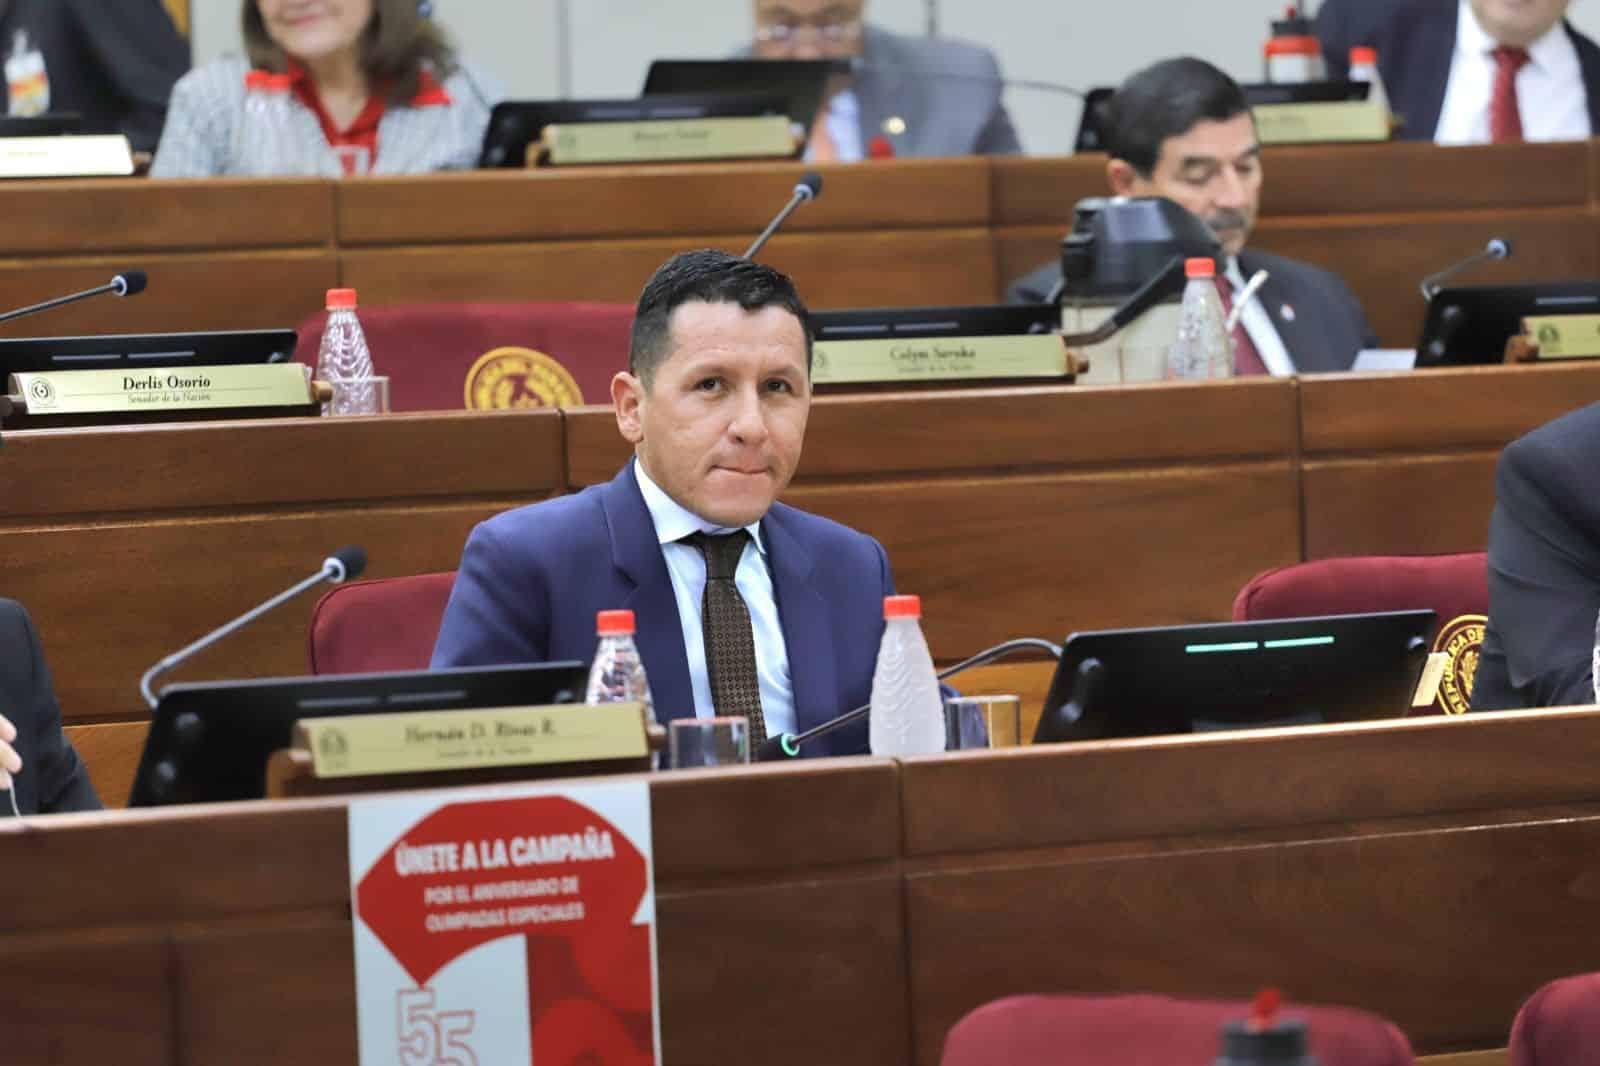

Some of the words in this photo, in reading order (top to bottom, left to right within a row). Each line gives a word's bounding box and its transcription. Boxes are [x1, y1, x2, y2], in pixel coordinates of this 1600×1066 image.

[123, 375, 162, 390] Derlis
[167, 374, 211, 389] Osorio
[394, 841, 459, 876] ÚNETE
[462, 840, 479, 870] A
[480, 838, 509, 869] LA
[510, 826, 615, 866] CAMPAÑA
[424, 884, 453, 906] POR
[454, 884, 472, 903] EL
[473, 878, 559, 901] ANIVERSARIO
[561, 875, 579, 894] DE
[425, 908, 505, 932] OLIMPIADAS
[508, 901, 585, 924] ESPECIALES
